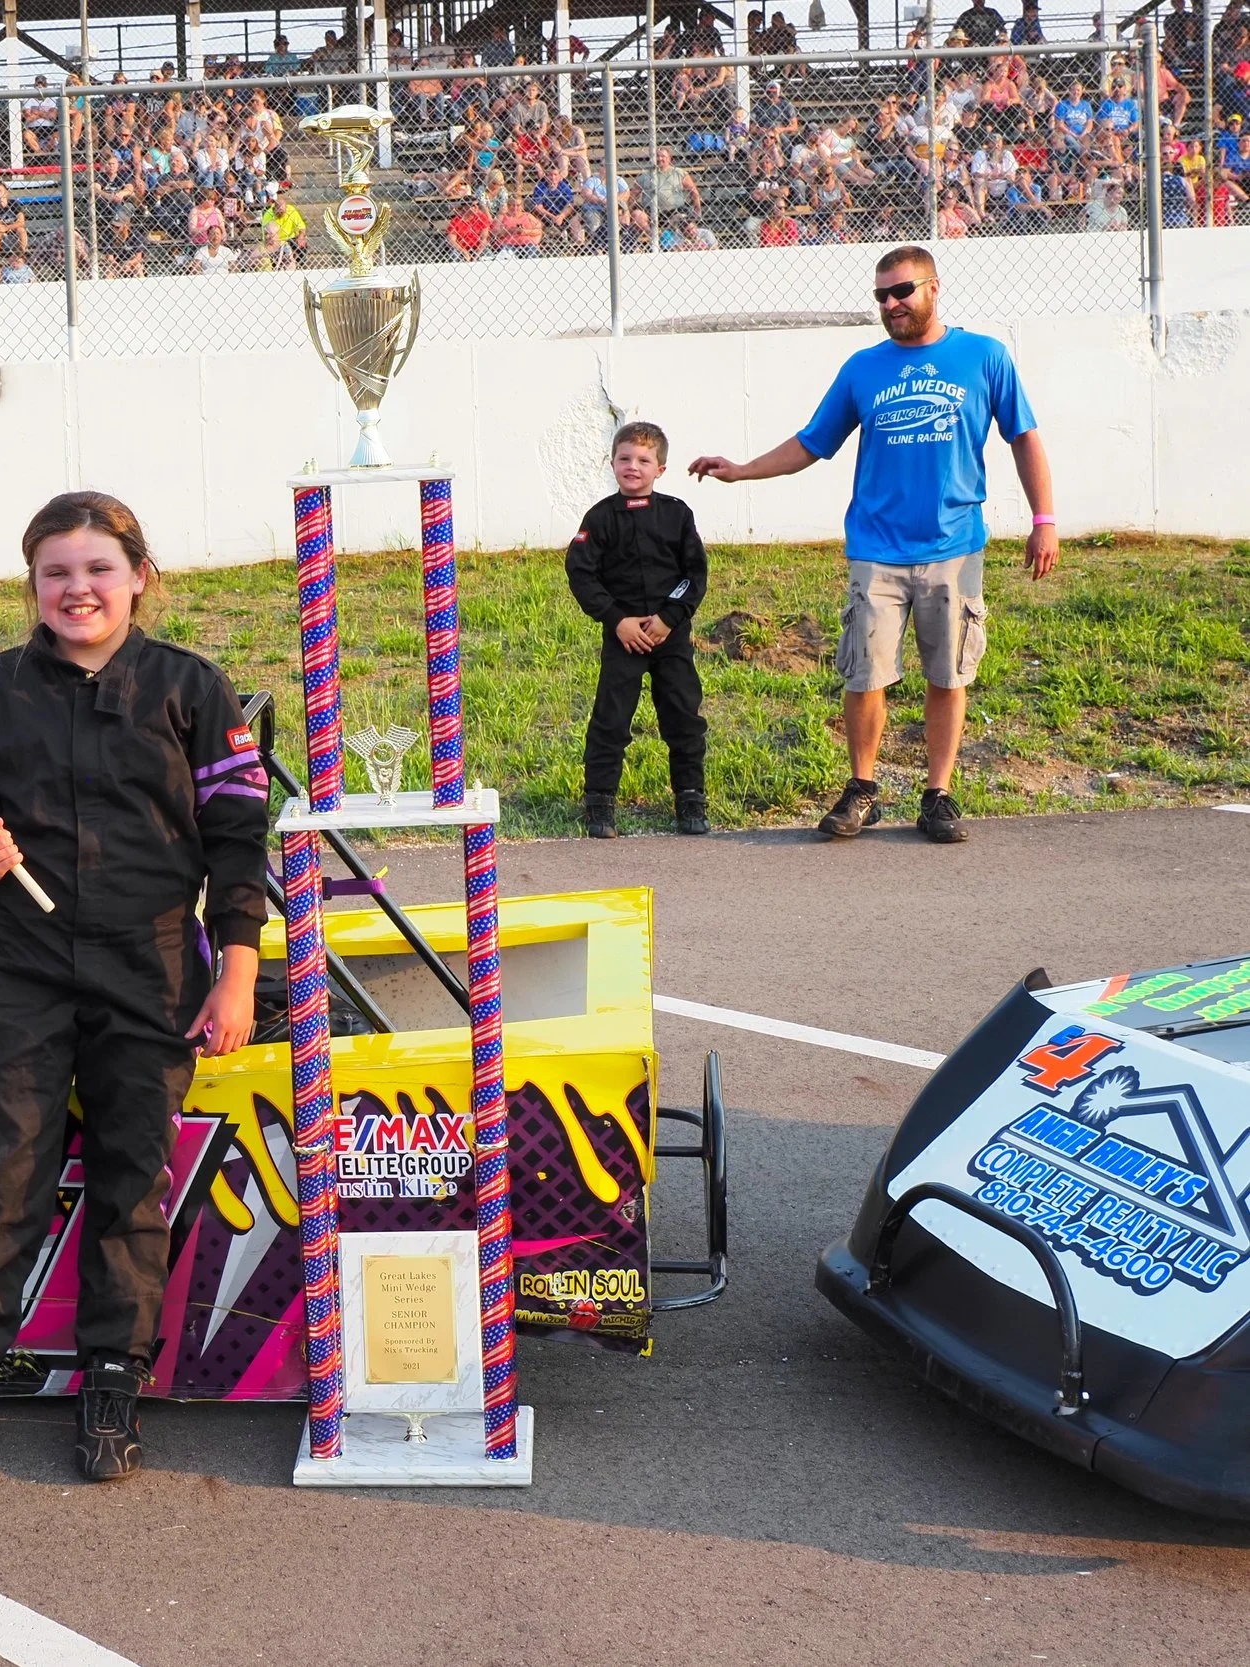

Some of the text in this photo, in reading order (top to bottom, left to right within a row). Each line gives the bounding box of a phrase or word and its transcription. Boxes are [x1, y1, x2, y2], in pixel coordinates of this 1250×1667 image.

[872, 379, 966, 409] MINI WEDGE
[875, 401, 963, 427] RACING FAMILY
[887, 431, 953, 445] KLINE RACING
[1017, 1032, 1126, 1098] 4
[334, 1115, 467, 1152] E/MAX
[341, 1156, 470, 1176] ELITE GROUP
[1010, 1106, 1209, 1207] ANGIE RIDLEY'S
[338, 1178, 392, 1197] ustin
[976, 1144, 1099, 1215] COMPLETE
[1085, 1194, 1191, 1259] REALTY
[979, 1181, 1172, 1288] 810-744-4600
[379, 1271, 437, 1281] Great Lakes
[594, 1270, 643, 1297] SOUL
[381, 1283, 437, 1293] Mini Wedge
[394, 1295, 424, 1304] Series
[391, 1310, 428, 1319] SENIOR
[383, 1321, 436, 1330] CHAMPION
[384, 1346, 438, 1354] Nix's Trucking
[385, 1338, 436, 1346] Sponsored By
[402, 1362, 420, 1371] 2021
